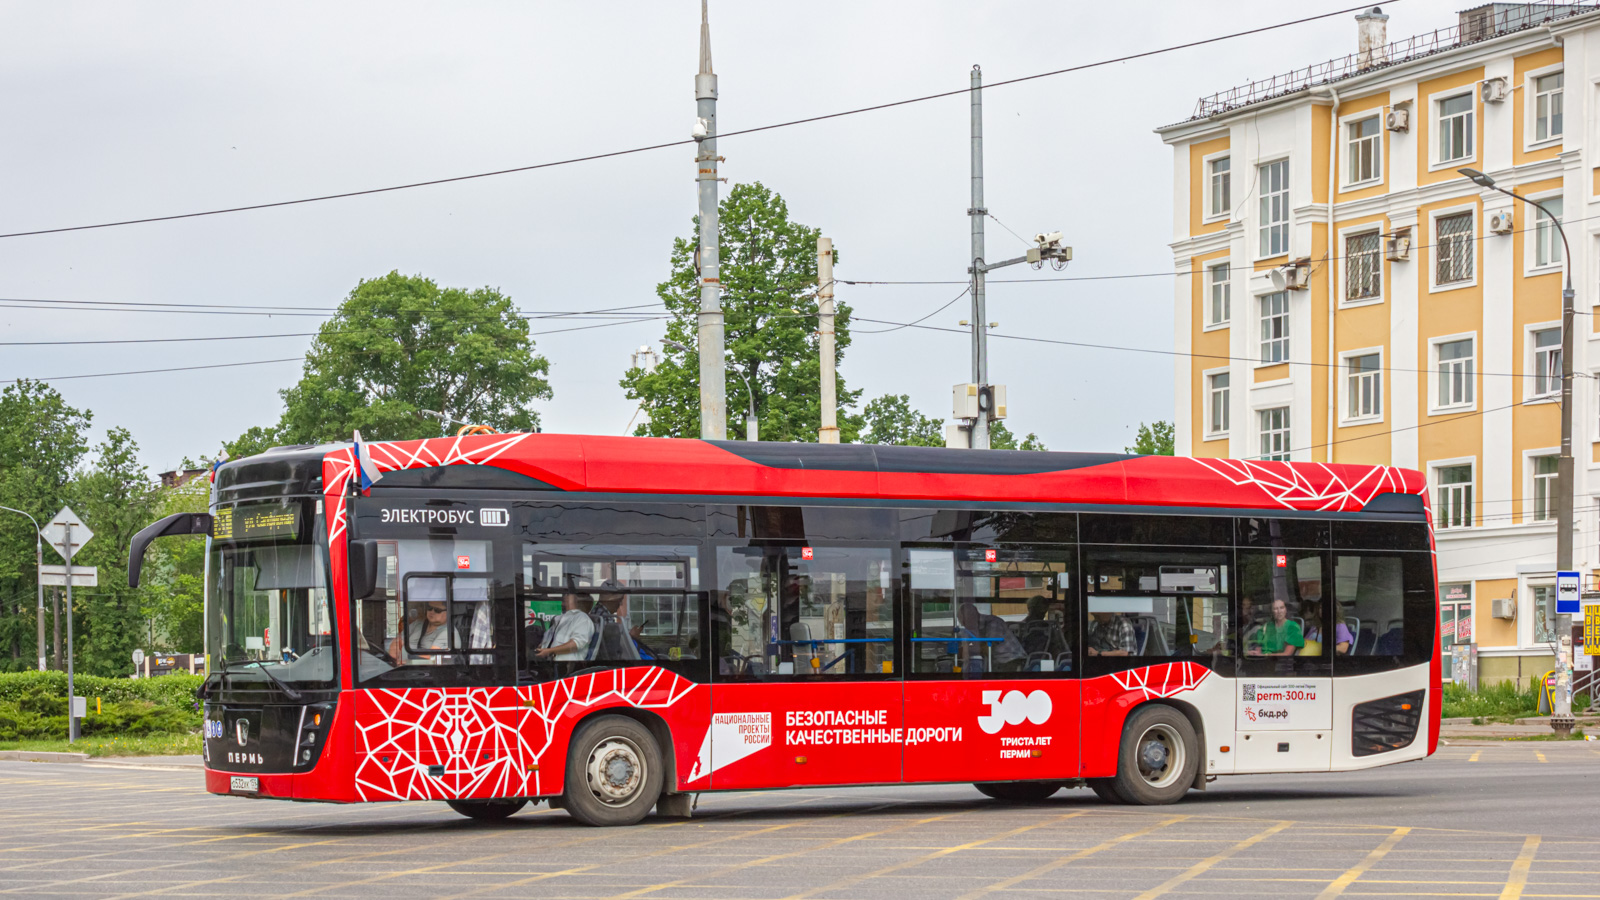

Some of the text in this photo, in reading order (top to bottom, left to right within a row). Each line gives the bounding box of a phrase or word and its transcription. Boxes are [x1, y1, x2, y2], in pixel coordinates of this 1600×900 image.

[381, 509, 474, 524] ЭЛЕКТРОБУС
[1257, 690, 1316, 703] perm-300.ru
[978, 690, 1052, 734] 300
[1258, 709, 1288, 719] бкд.рф
[715, 714, 770, 725] НАЦИОНАЛЬНЫЕ
[786, 710, 887, 726] БЕЗОПАСНЫЕ
[738, 724, 770, 734] ПРОЕКТЫ
[744, 734, 770, 744] РОССИИ
[786, 727, 962, 745] КАЧЕСТВЕННЫЕ ДОРОГИ
[1001, 736, 1052, 746] ТРИСТА ЛЕТ
[228, 752, 263, 764] ПЕРМЬ
[1000, 749, 1030, 758] ПЕРМИ
